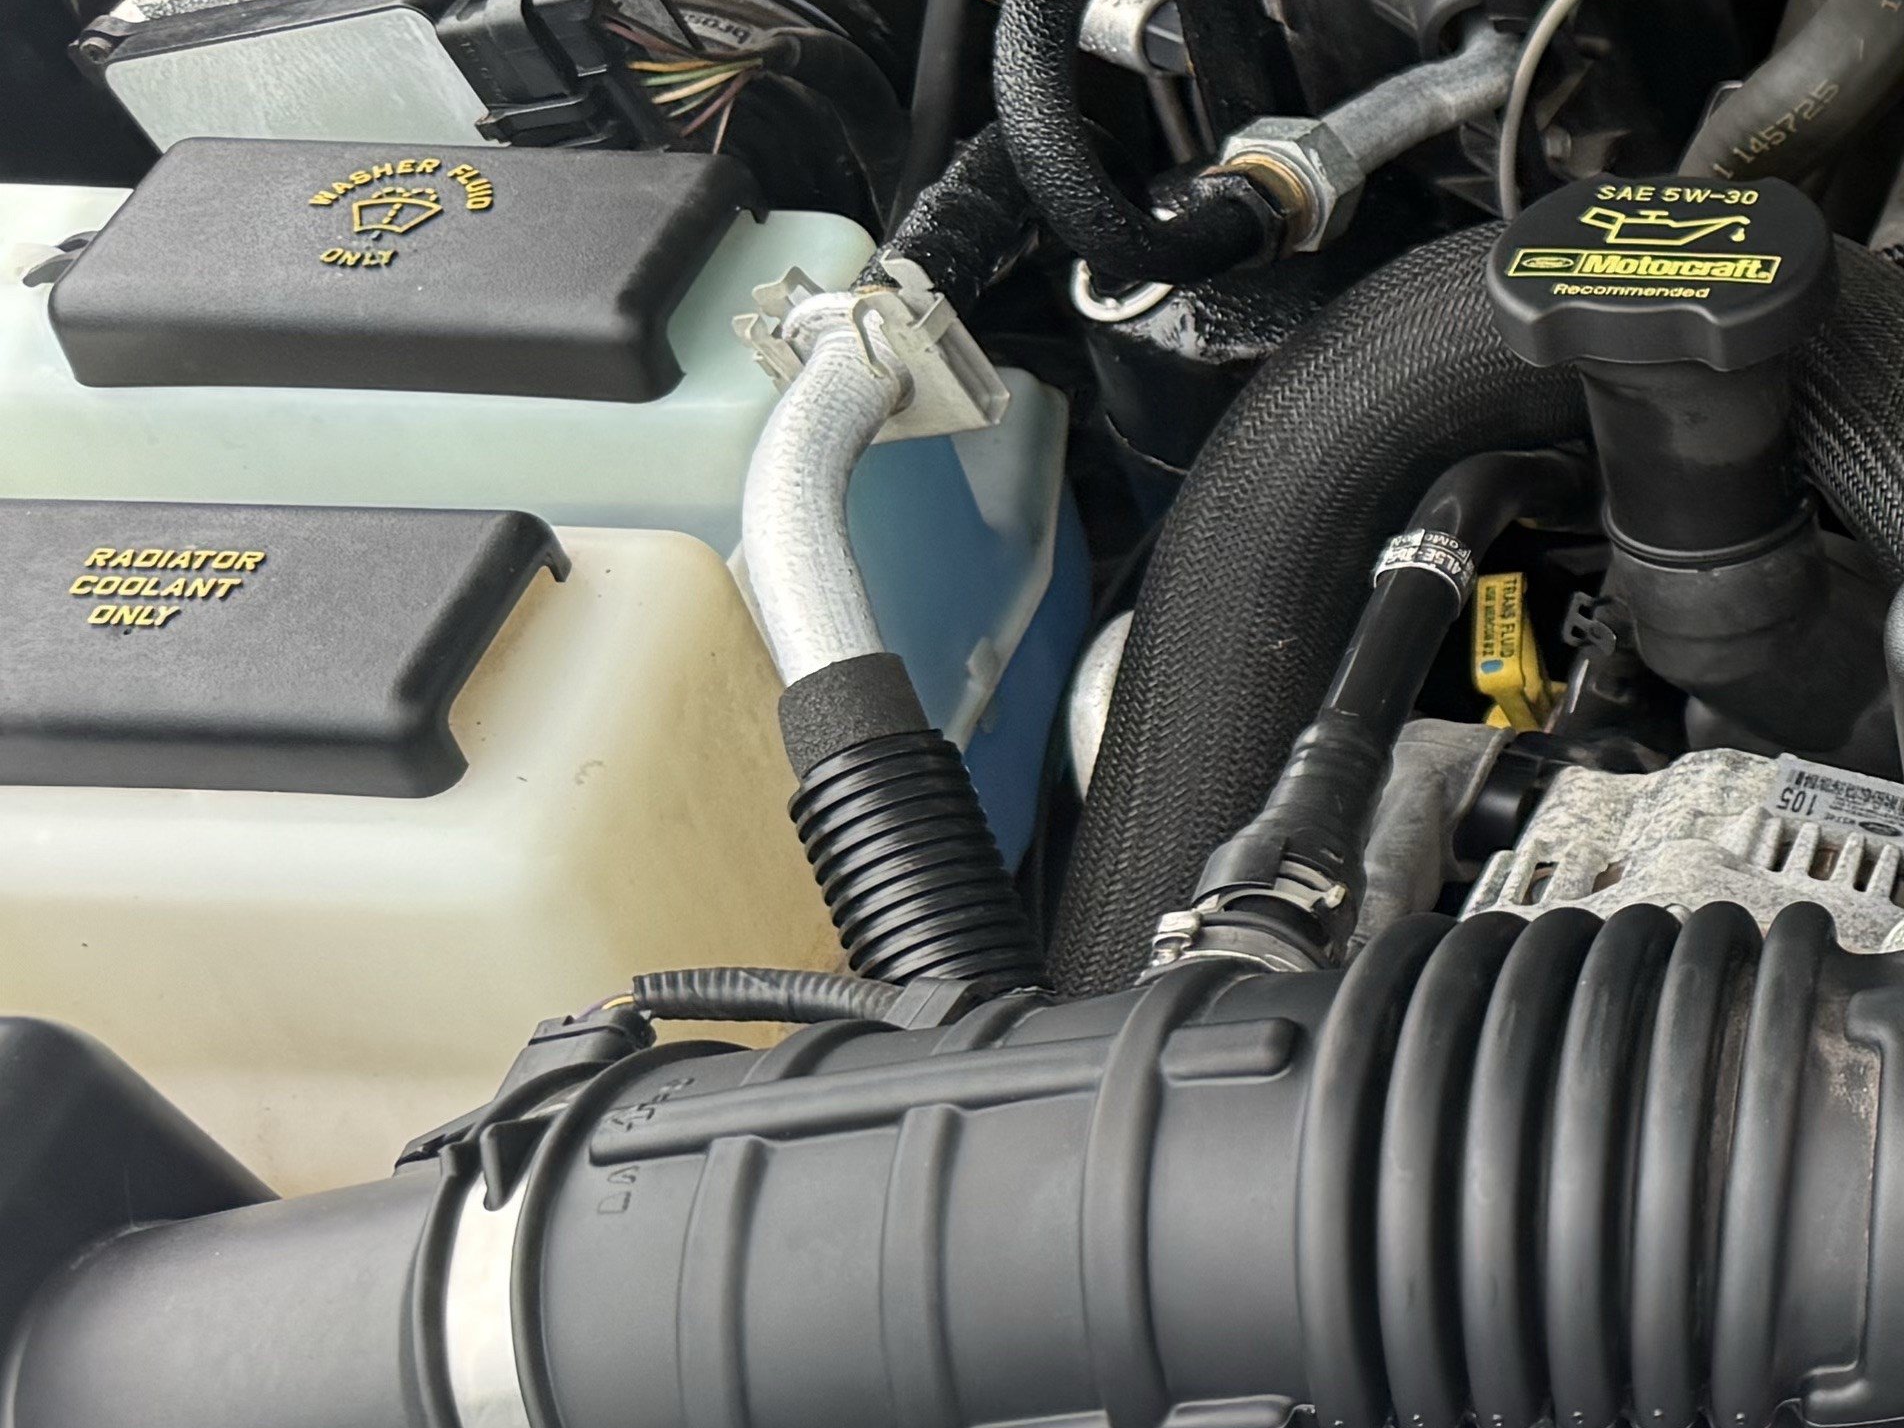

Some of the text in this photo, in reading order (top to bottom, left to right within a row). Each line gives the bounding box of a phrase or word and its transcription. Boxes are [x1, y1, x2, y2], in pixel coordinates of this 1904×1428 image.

[309, 158, 495, 212] WASHER FLUID
[1596, 184, 1760, 206] SAE 5W-30
[319, 246, 399, 269] ONLY
[1582, 252, 1764, 279] Motorcraft
[1552, 282, 1711, 299] Recommended
[83, 546, 266, 574] RADIATOR
[69, 574, 244, 602] COOLANT
[88, 604, 182, 630] ONLY
[1498, 578, 1517, 658] TRANS FLUID
[1776, 786, 1818, 816] 105
